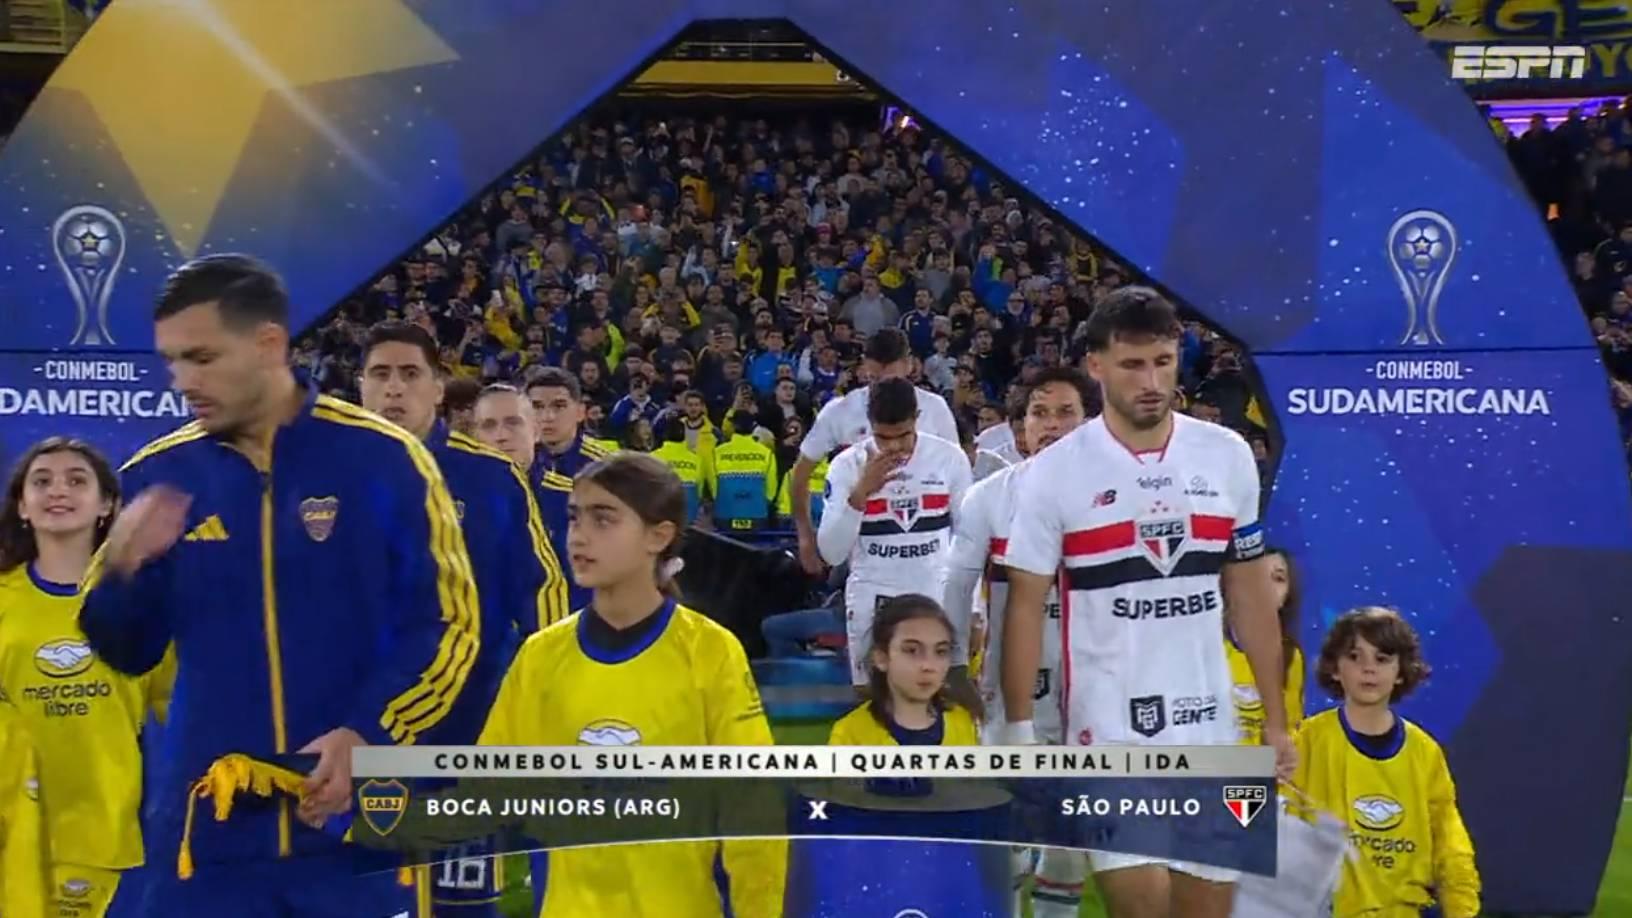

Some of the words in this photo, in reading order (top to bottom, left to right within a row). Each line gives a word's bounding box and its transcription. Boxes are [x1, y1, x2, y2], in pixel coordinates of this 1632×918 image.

[0, 388, 188, 417] DAMERICA
[1287, 387, 1552, 415] SUDAMERICANA
[1111, 590, 1218, 620] SUPERBE
[23, 680, 112, 701] mercado
[43, 699, 90, 718] libre
